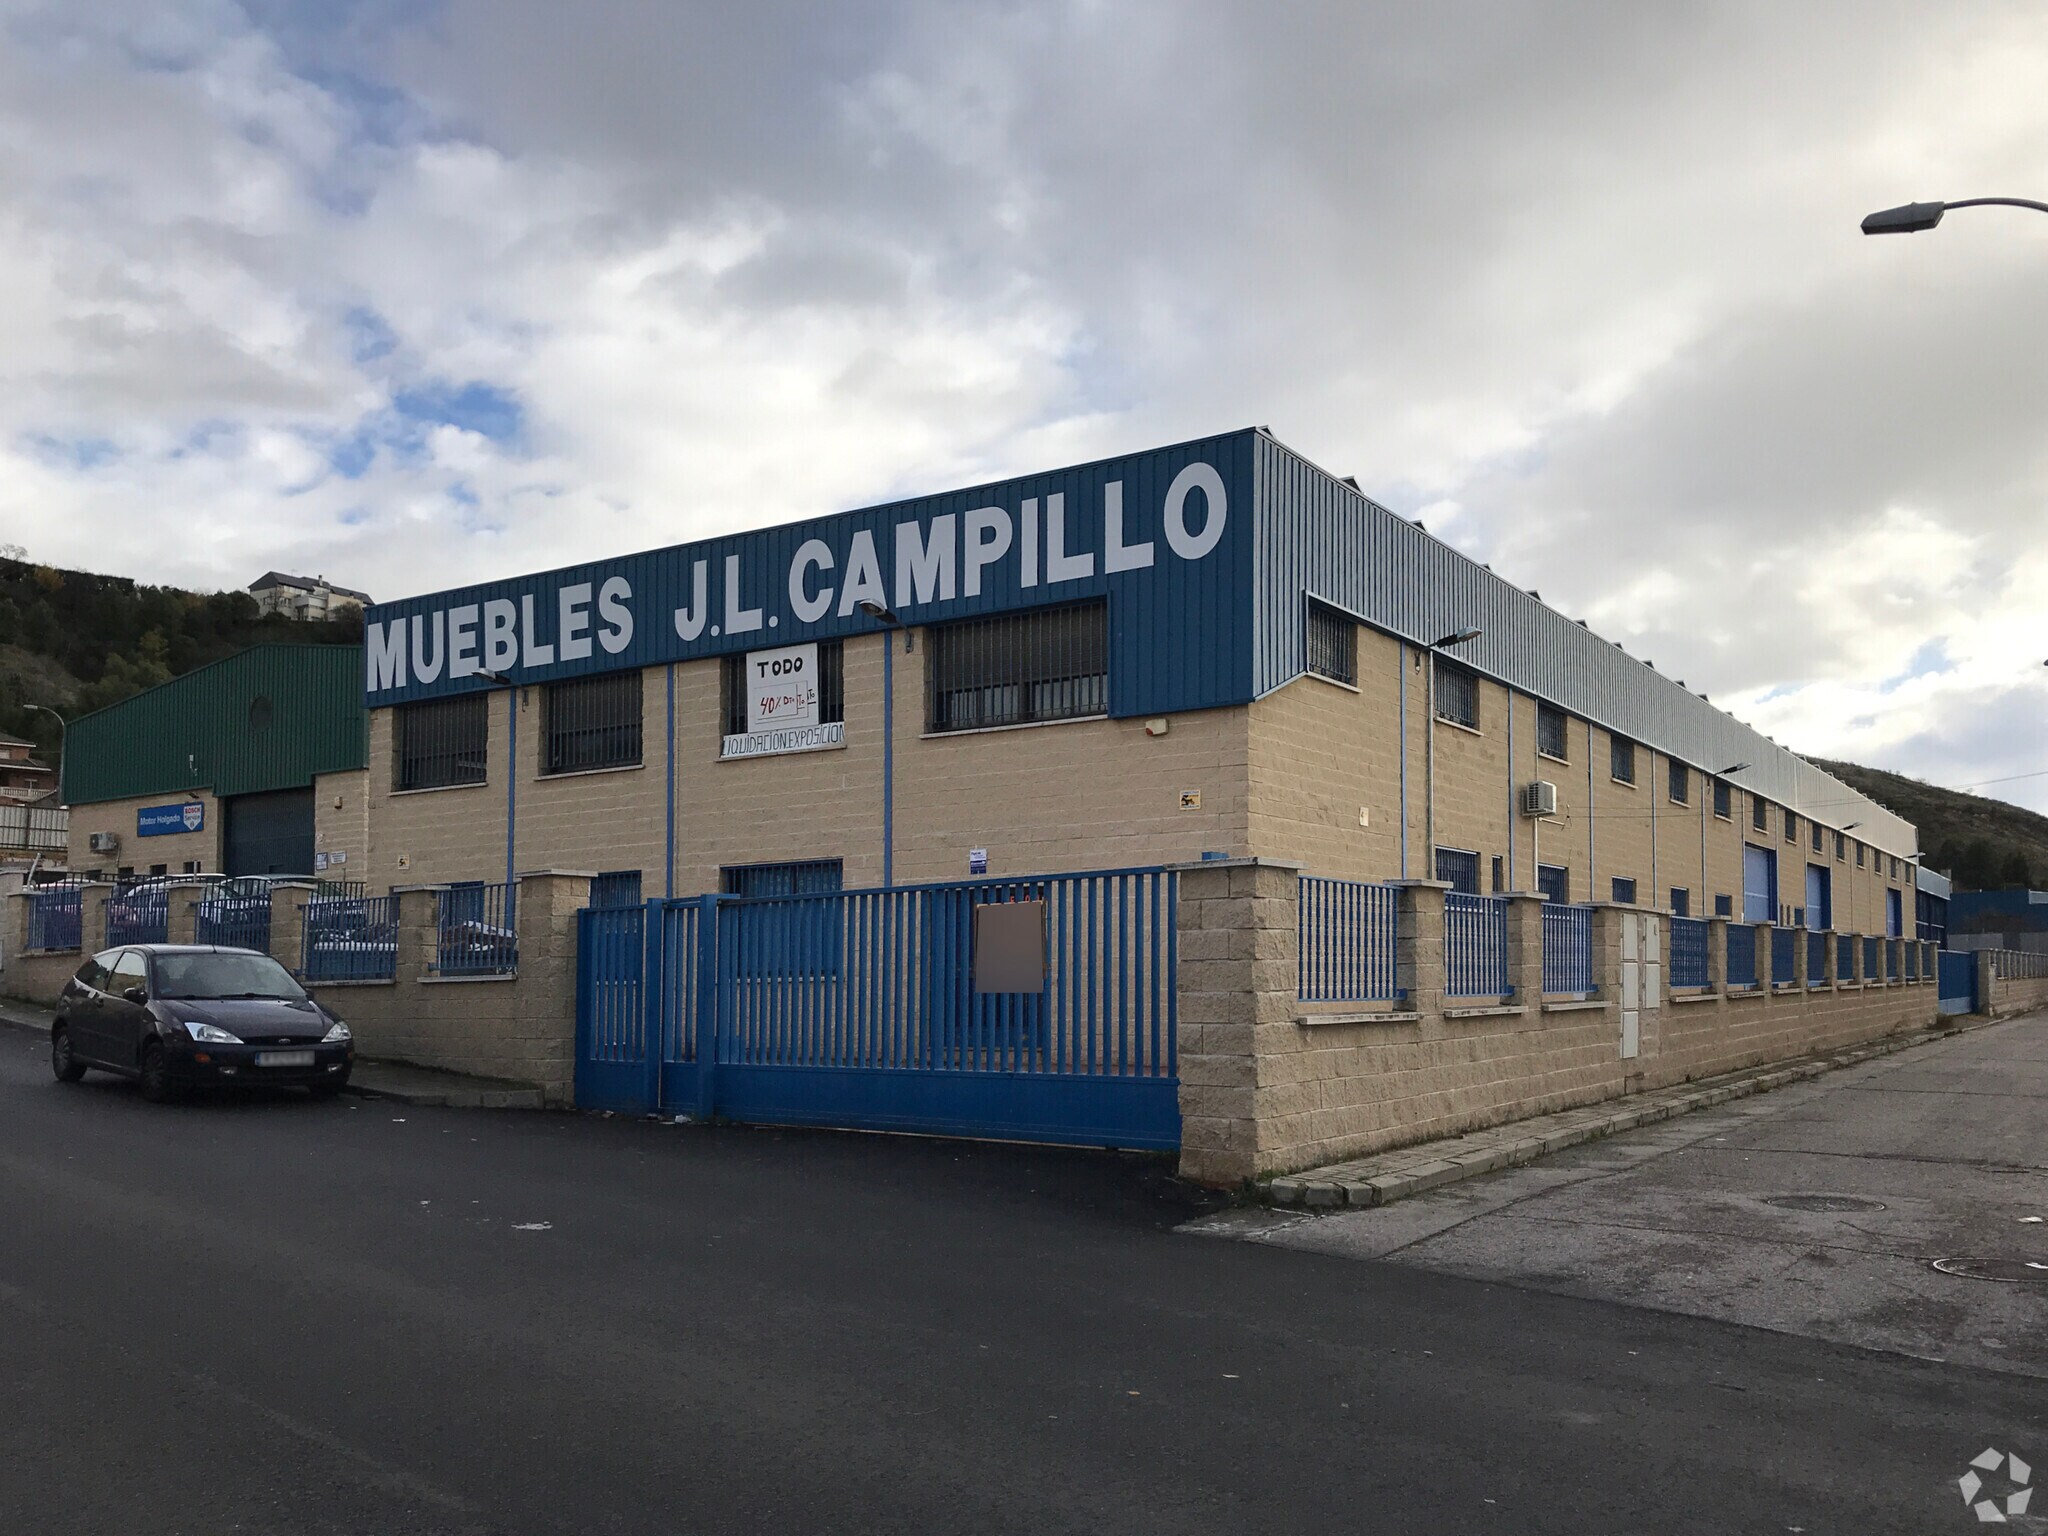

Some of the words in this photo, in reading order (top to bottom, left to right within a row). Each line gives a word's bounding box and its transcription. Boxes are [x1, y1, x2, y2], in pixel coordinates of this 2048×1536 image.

[367, 576, 633, 692] MUEBLES
[757, 657, 803, 678] TODO
[760, 696, 781, 715] 40%
